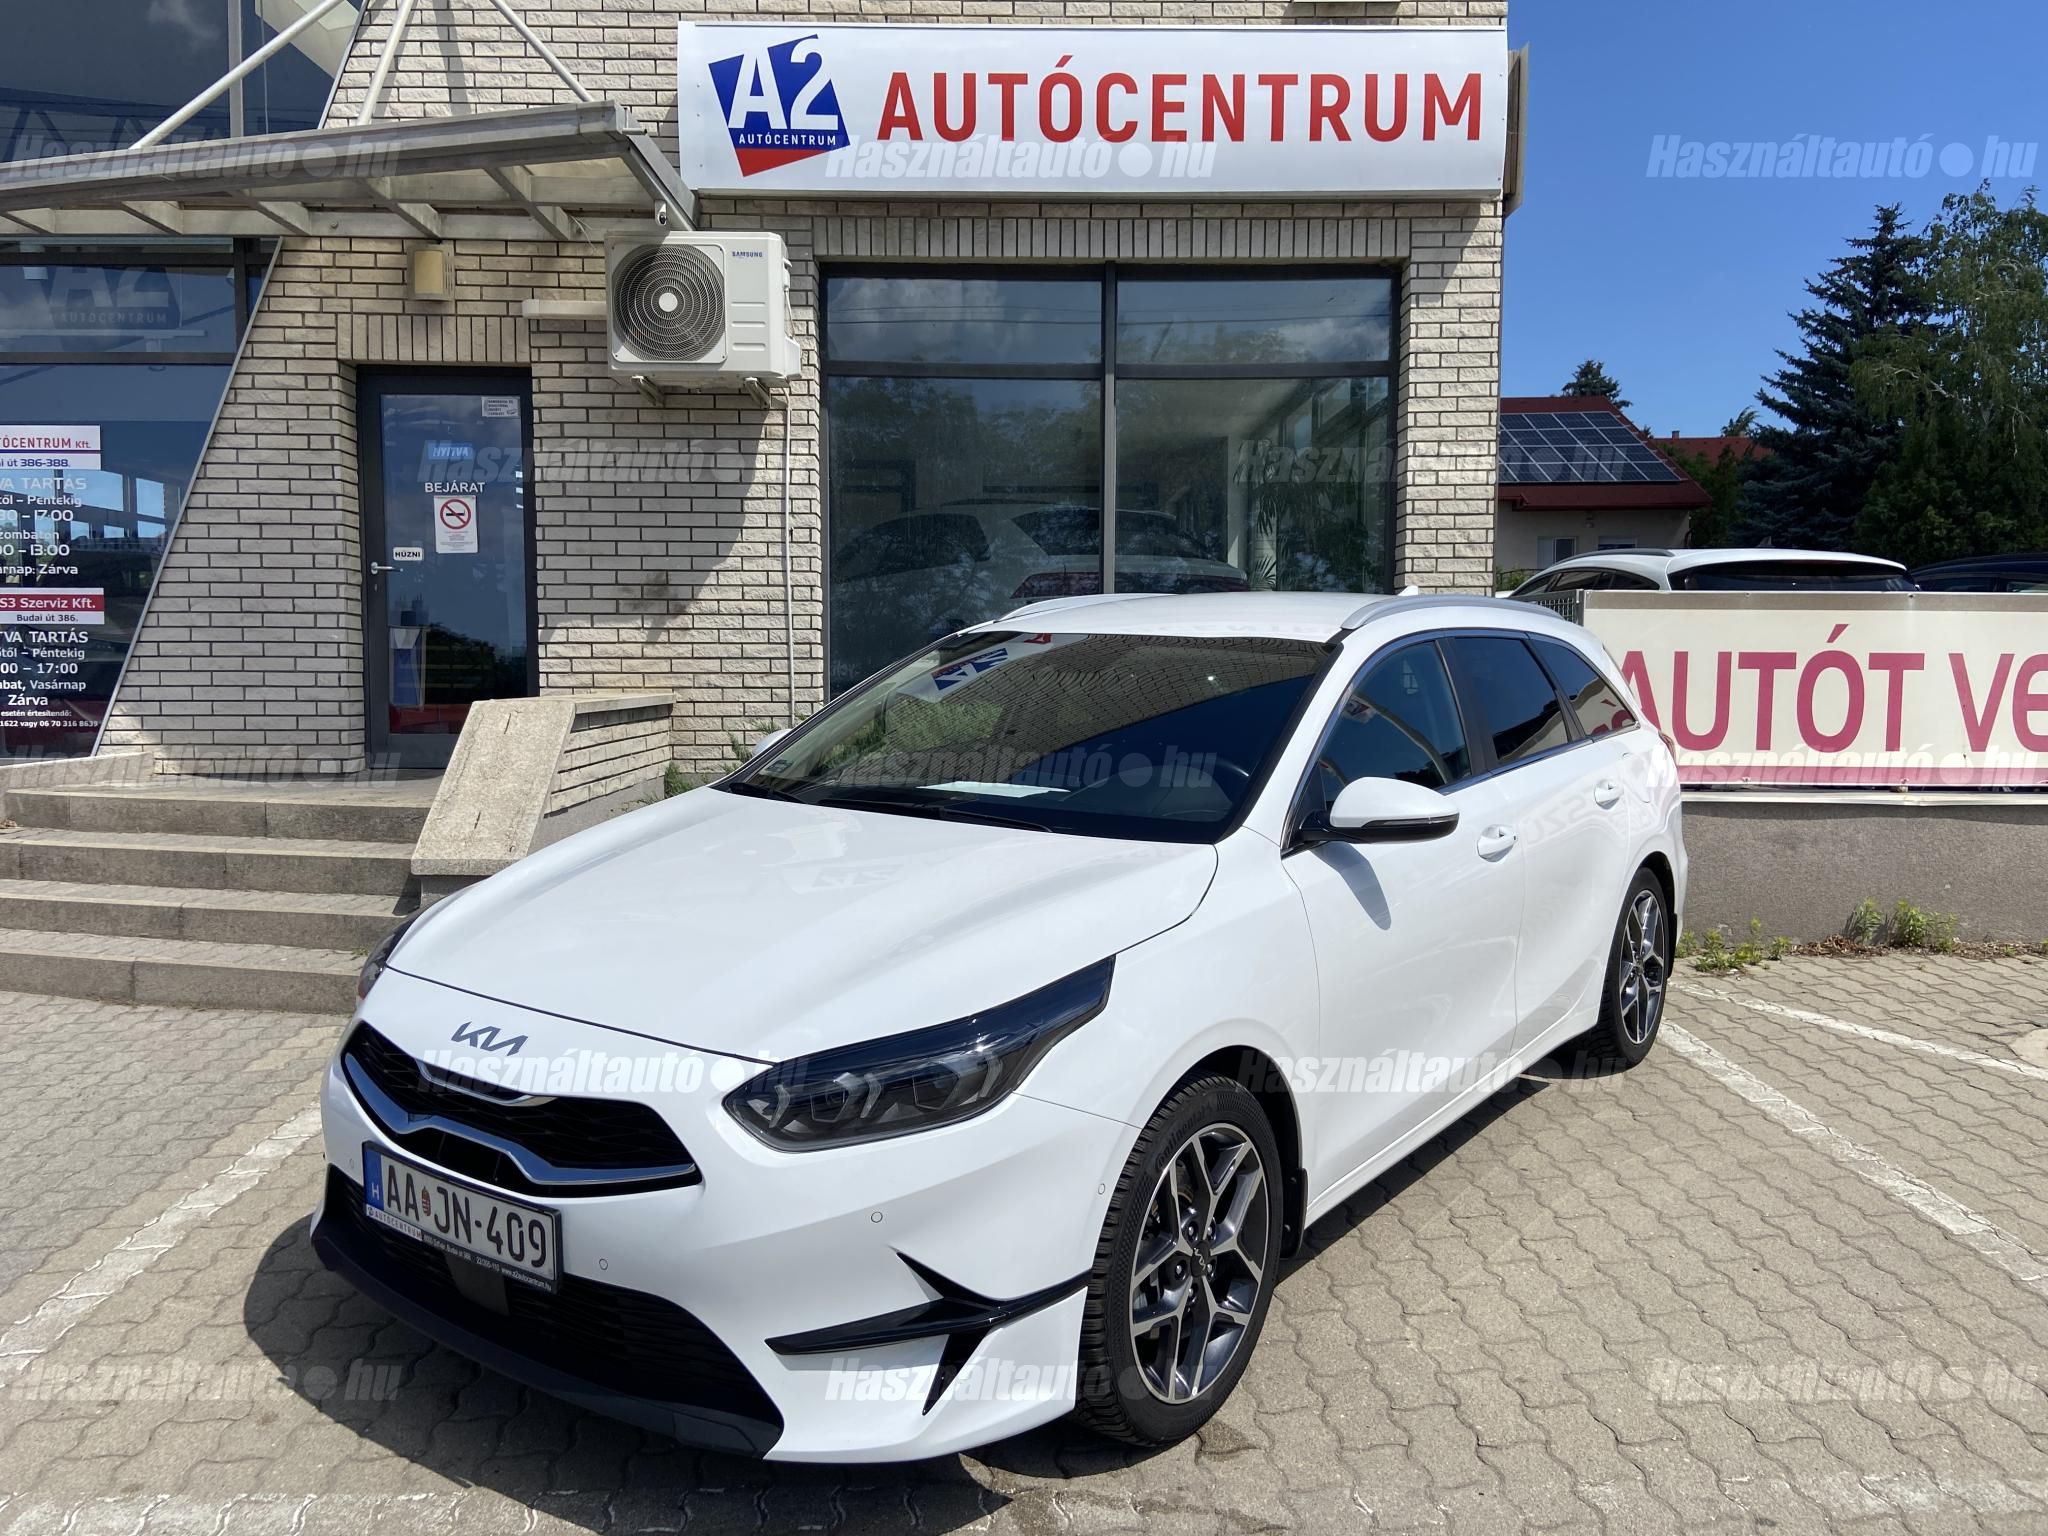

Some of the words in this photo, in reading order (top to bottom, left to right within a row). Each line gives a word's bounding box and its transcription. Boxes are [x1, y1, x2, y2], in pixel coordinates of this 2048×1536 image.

[728, 37, 838, 130] A2
[877, 55, 1481, 143] AUTÓCENTRUM
[739, 132, 836, 145] AUTÓCENTRUM
[0, 435, 71, 448] ÓCENTRUM
[21, 475, 87, 490] TARTÁS
[425, 480, 485, 493] BEJÁRAT
[31, 544, 70, 556] 13:00
[38, 563, 79, 575] Zárva
[20, 597, 68, 609] Szerviz
[72, 597, 96, 609] Kft.
[16, 613, 42, 622] Budai
[46, 613, 55, 622] út
[29, 627, 89, 643] TARTÁS
[32, 646, 86, 660] Péntekig
[36, 662, 79, 674] 17:00
[29, 678, 87, 692] Vasárnap
[7, 693, 49, 706] Zárva
[451, 1021, 528, 1057] KIA
[371, 1182, 380, 1201] H
